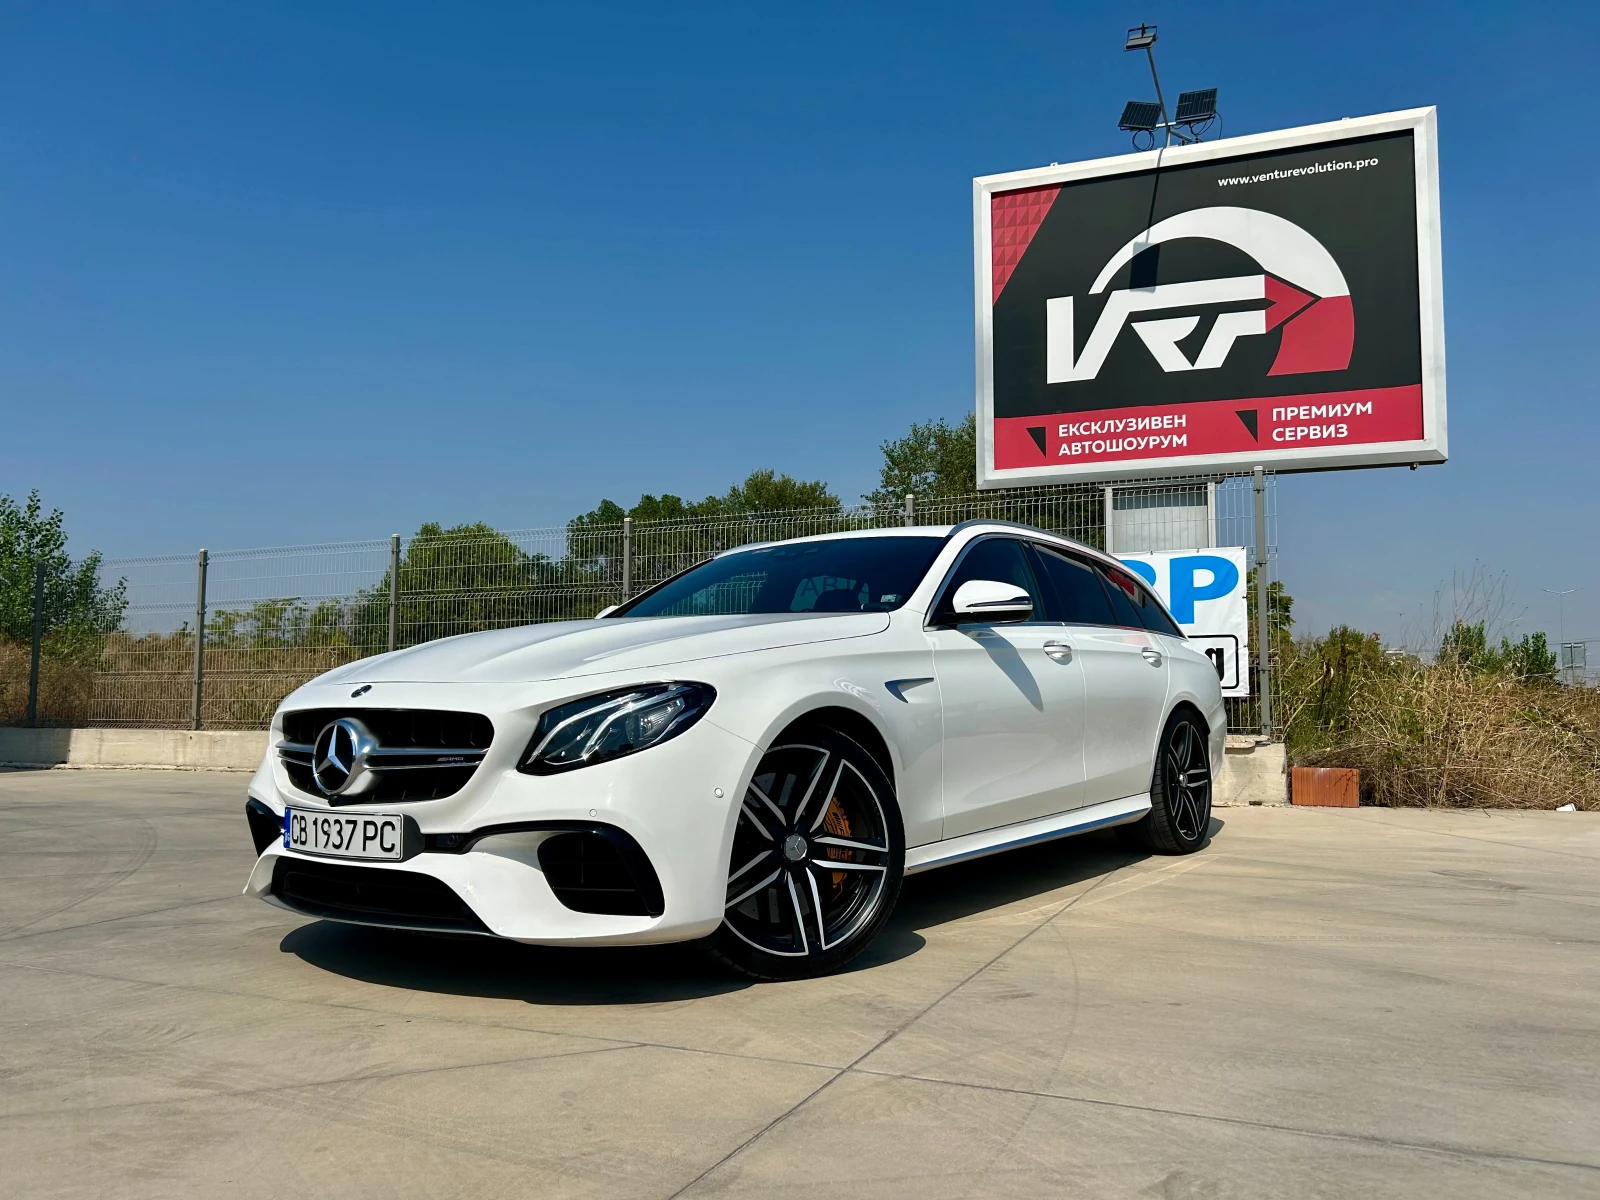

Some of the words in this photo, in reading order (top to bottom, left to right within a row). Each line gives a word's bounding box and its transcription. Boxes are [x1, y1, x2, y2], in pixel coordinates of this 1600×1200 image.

[1217, 157, 1379, 187] www.venturevolution.pro
[1272, 401, 1372, 421] ПРЕМИУМ
[1058, 414, 1187, 437] ЕКСКЛУЗИВЕН
[1272, 423, 1348, 442] СЕРВИЗ
[1058, 433, 1188, 456] АВТОШОУРУМ
[291, 814, 308, 846] CB
[312, 816, 358, 851] 1937
[362, 820, 396, 853] PC
